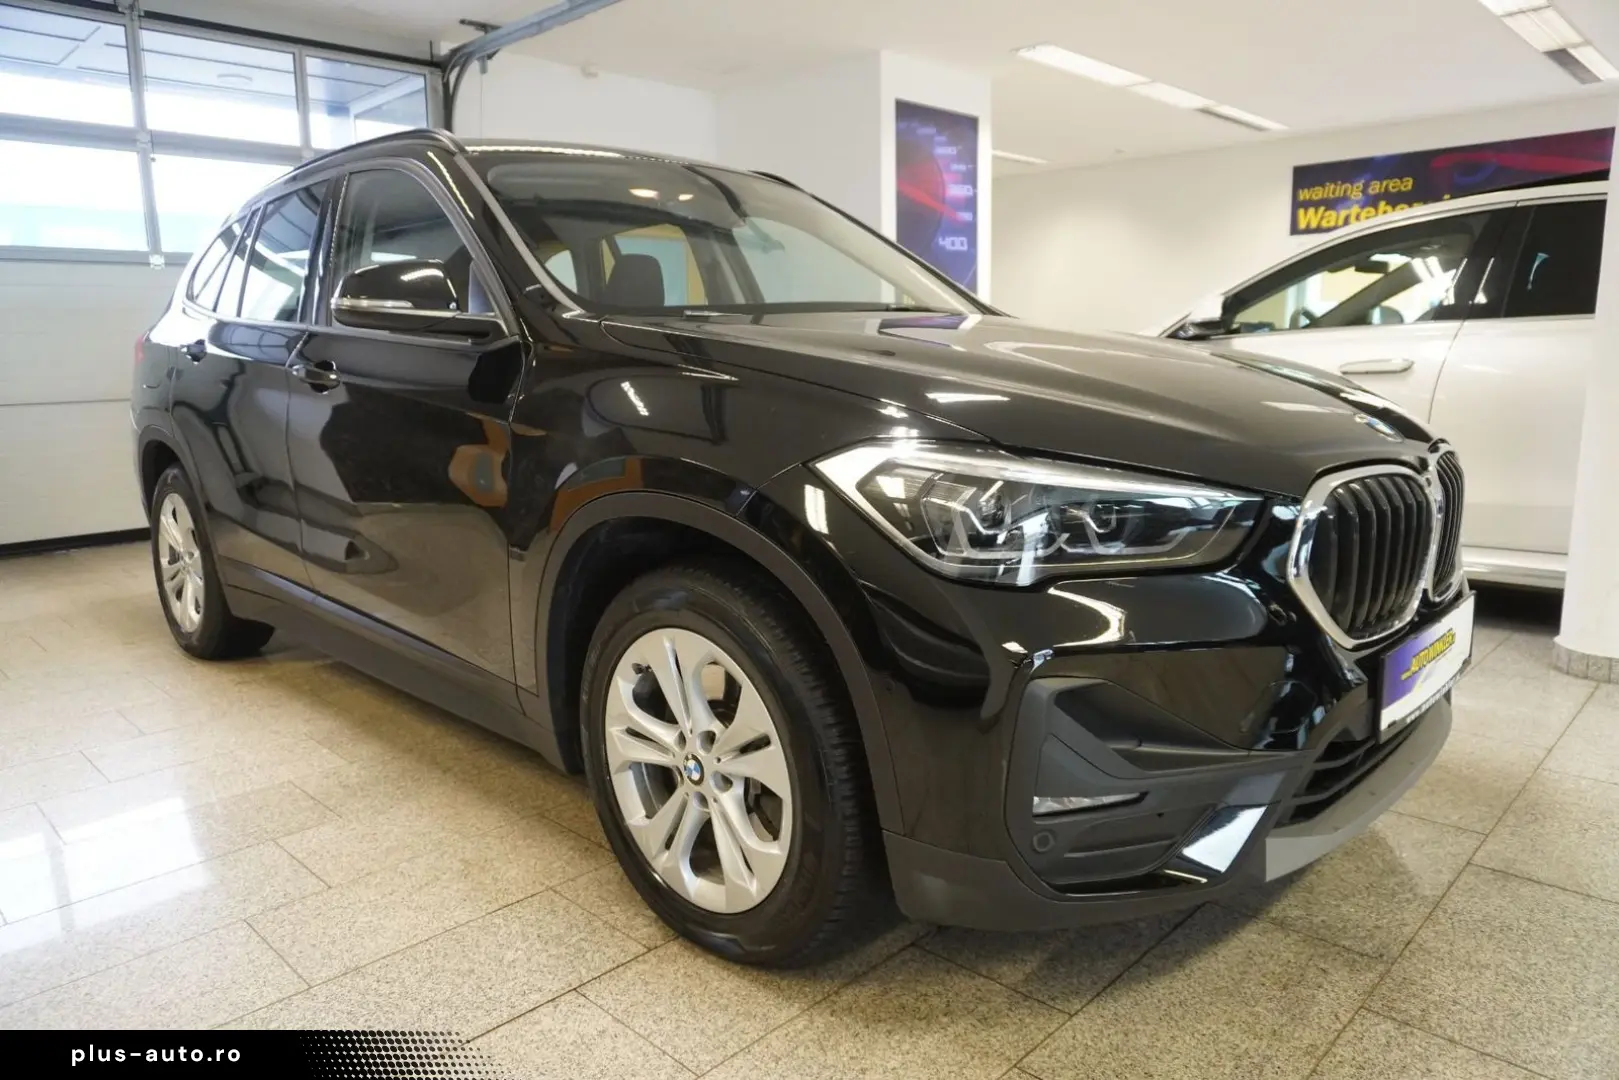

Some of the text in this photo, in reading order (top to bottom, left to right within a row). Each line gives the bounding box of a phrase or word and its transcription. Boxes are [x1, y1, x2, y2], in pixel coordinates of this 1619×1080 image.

[1298, 176, 1414, 200] waiting area
[938, 236, 968, 251] 400
